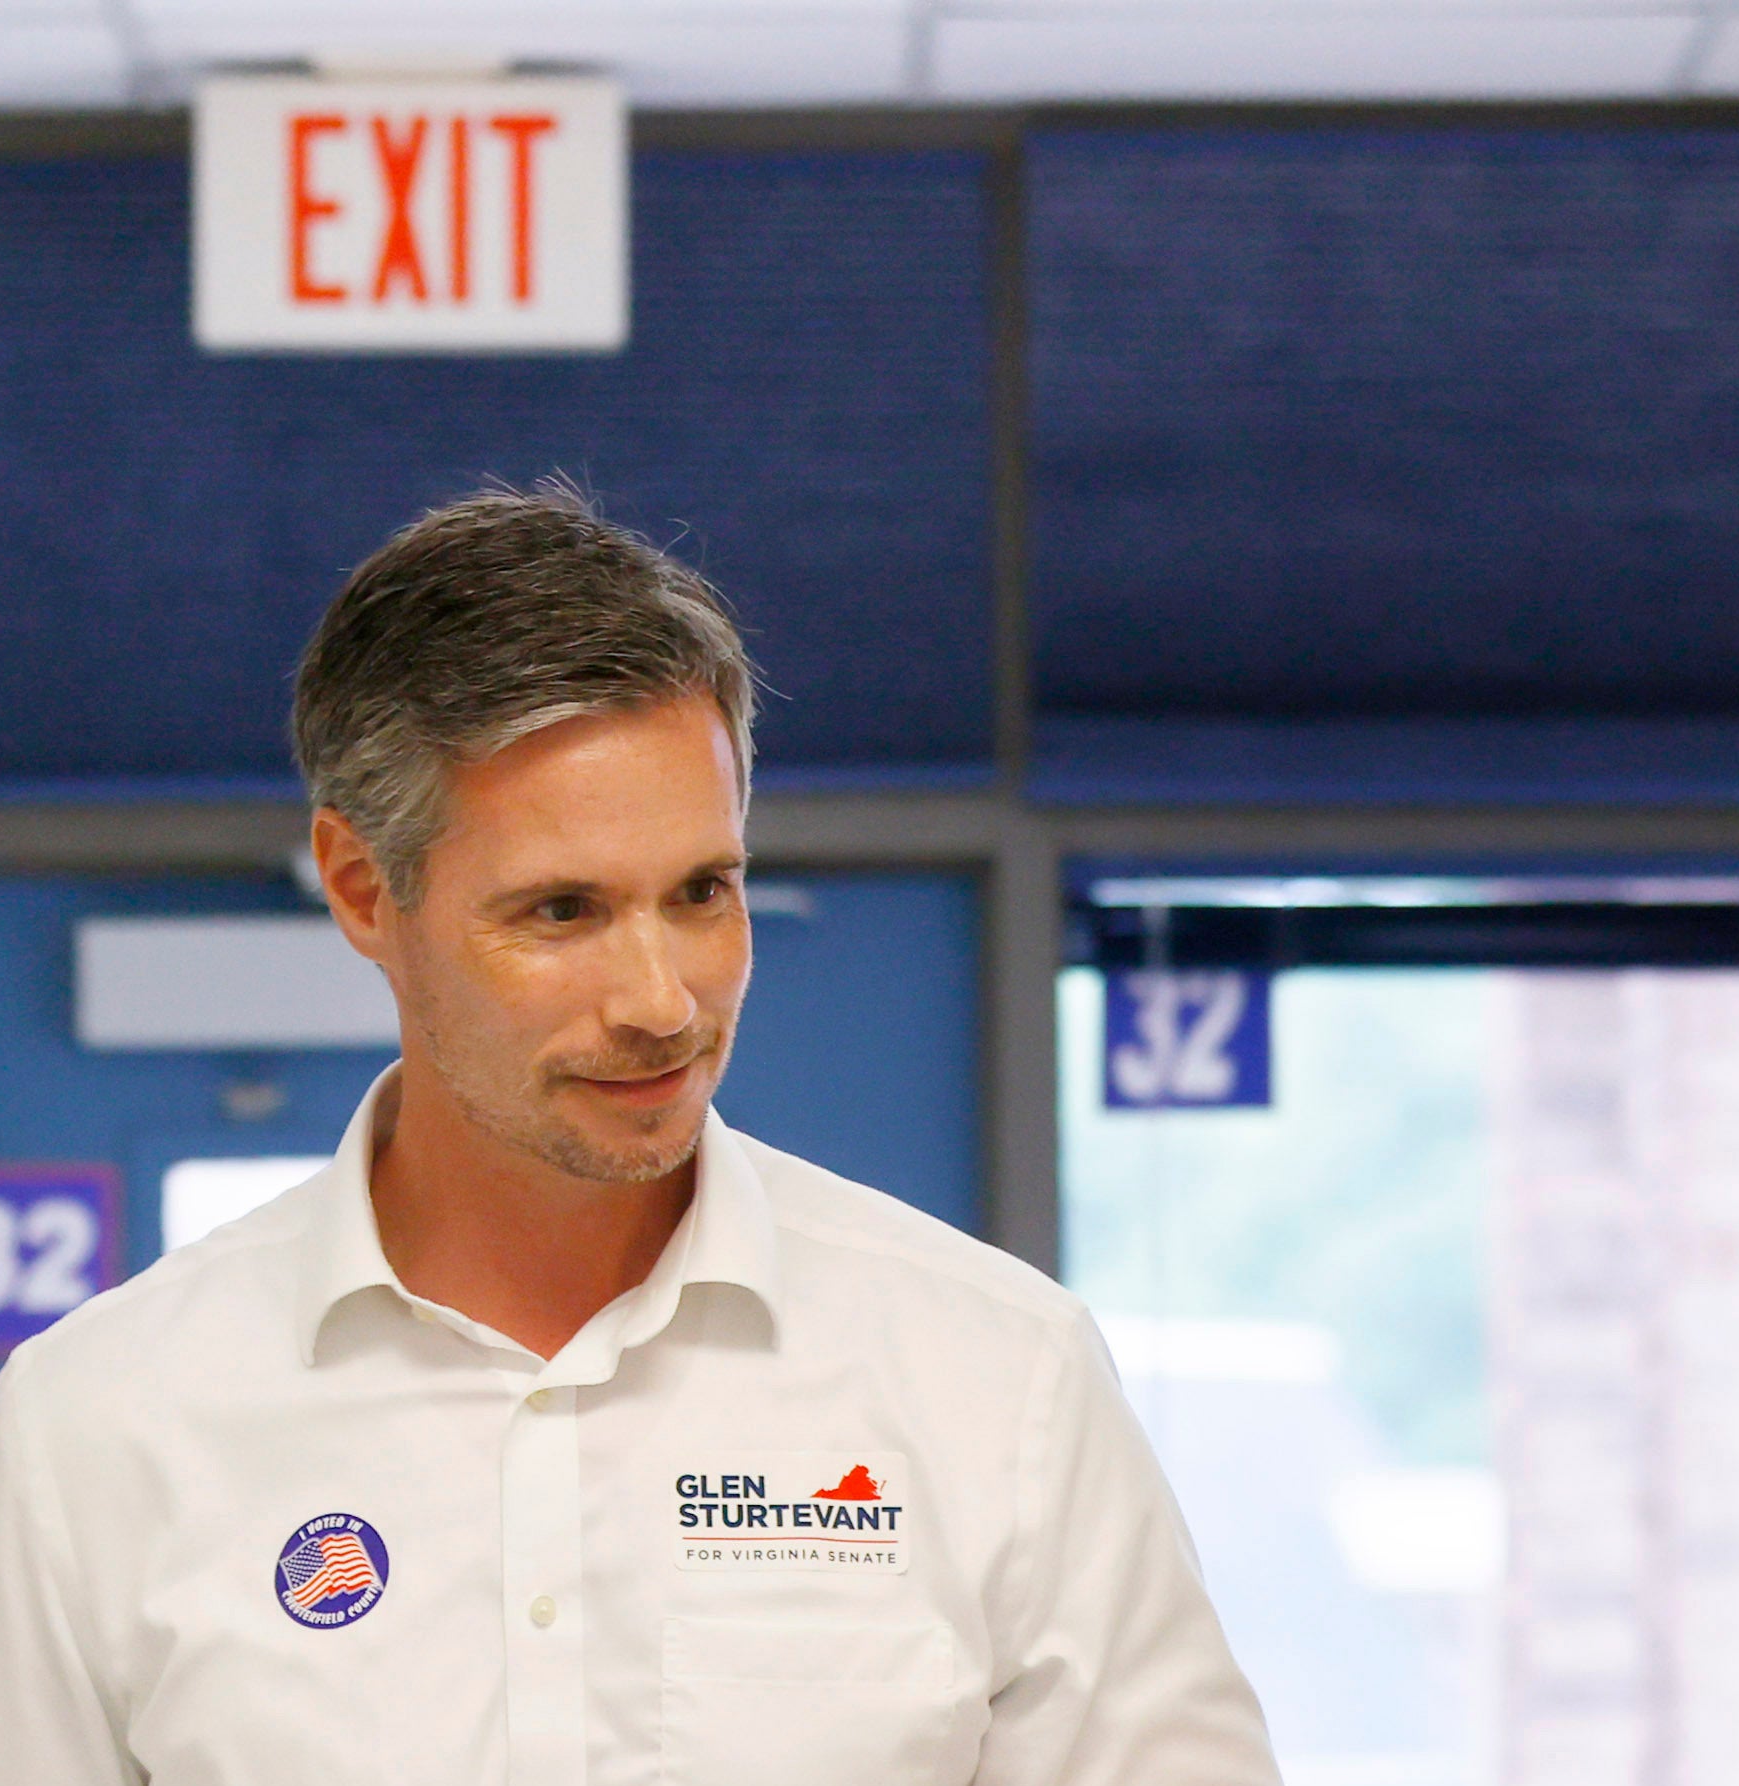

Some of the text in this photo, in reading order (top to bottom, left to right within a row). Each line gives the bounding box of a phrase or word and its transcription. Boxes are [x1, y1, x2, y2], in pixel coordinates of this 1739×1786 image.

[290, 115, 555, 304] EXIT
[1114, 969, 1246, 1099] 32
[675, 1474, 766, 1499] GLEN
[298, 1515, 364, 1541] I VOTED IN
[679, 1503, 903, 1531] STURTEVANT
[686, 1549, 897, 1564] FOR VIRGINIA SENATE
